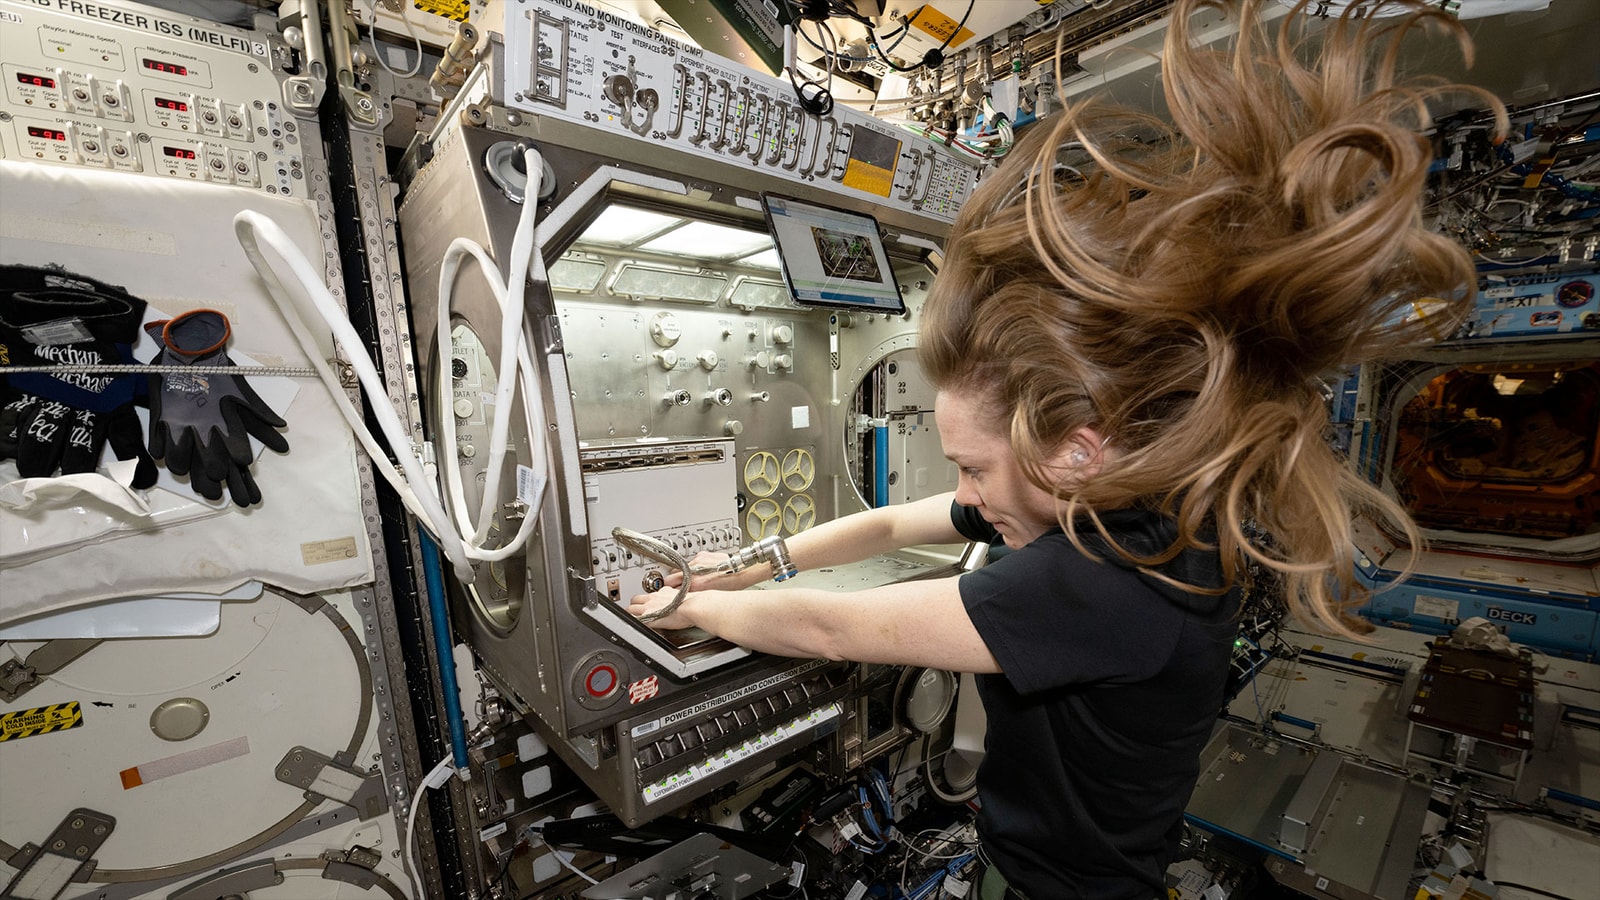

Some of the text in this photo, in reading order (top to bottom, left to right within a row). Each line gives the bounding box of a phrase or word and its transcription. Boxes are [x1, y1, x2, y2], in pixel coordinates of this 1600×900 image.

[60, 0, 148, 29] FREEZER
[154, 19, 183, 37] ISS
[188, 27, 251, 54] (MELFI)
[575, 4, 595, 17] AND
[597, 10, 653, 39] MONITORING
[655, 33, 681, 51] PANEL
[682, 43, 704, 58] (CMP)
[568, 30, 588, 42] TATUS
[611, 30, 624, 40] TEST
[255, 43, 265, 56] 3
[632, 38, 660, 54] INTERFACES
[20, 77, 56, 89] -97
[157, 100, 187, 112] -98
[30, 131, 65, 142] -96
[175, 149, 195, 159] 02
[34, 343, 103, 365] Mechan
[454, 391, 470, 399] DATA
[1488, 608, 1536, 625] DECK
[664, 709, 692, 724] POWER
[694, 691, 743, 714] DISTRIBUTION
[743, 684, 758, 696] AND
[759, 670, 798, 691] CONVERSION
[798, 664, 813, 676] BOX
[4, 713, 46, 726] WARNING
[5, 718, 46, 731] COLD INSIDE
[654, 780, 681, 798] EXPERIMENT
